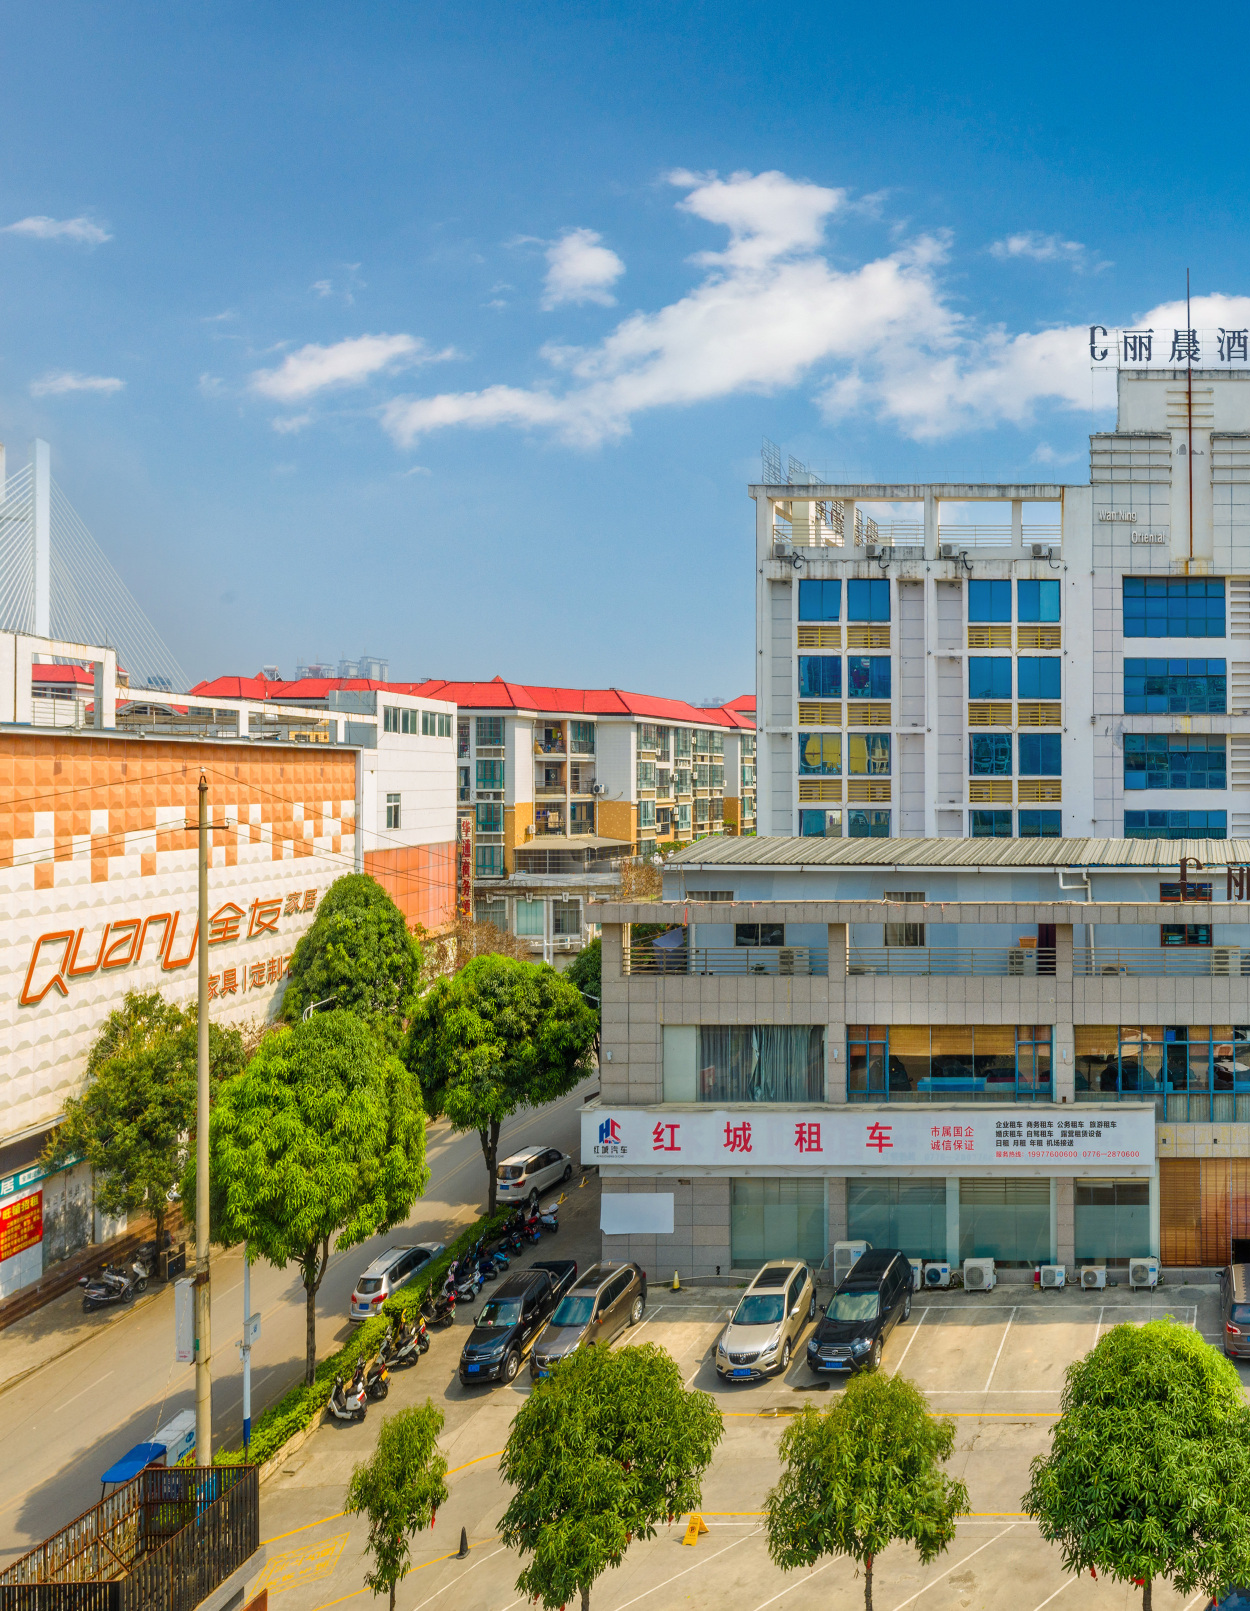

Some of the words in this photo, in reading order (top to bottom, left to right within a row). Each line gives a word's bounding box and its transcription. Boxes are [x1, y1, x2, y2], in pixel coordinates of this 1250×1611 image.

[1099, 510, 1117, 521] Wan
[1119, 510, 1137, 523] Ning
[1131, 531, 1165, 544] Oriental
[208, 897, 283, 944] 全友
[284, 888, 318, 914] 家居
[995, 1121, 1023, 1129] 企业租车
[1026, 1121, 1054, 1129] 商务租车
[1057, 1121, 1085, 1129] 公务租车
[1089, 1121, 1117, 1129] 旅游租车
[652, 1121, 894, 1153] 红城租车
[930, 1126, 974, 1138] 市属国企
[995, 1130, 1023, 1138] 婚庆租车
[1026, 1130, 1054, 1138] 自驾租车
[930, 1139, 975, 1151] 诚信保证
[995, 1139, 1009, 1147] 日租
[1012, 1139, 1026, 1147] 月租
[1029, 1139, 1043, 1147] 年租
[1046, 1139, 1074, 1147] 机场接送
[593, 1145, 628, 1154] 红城汽车
[1, 1177, 14, 1196] 居
